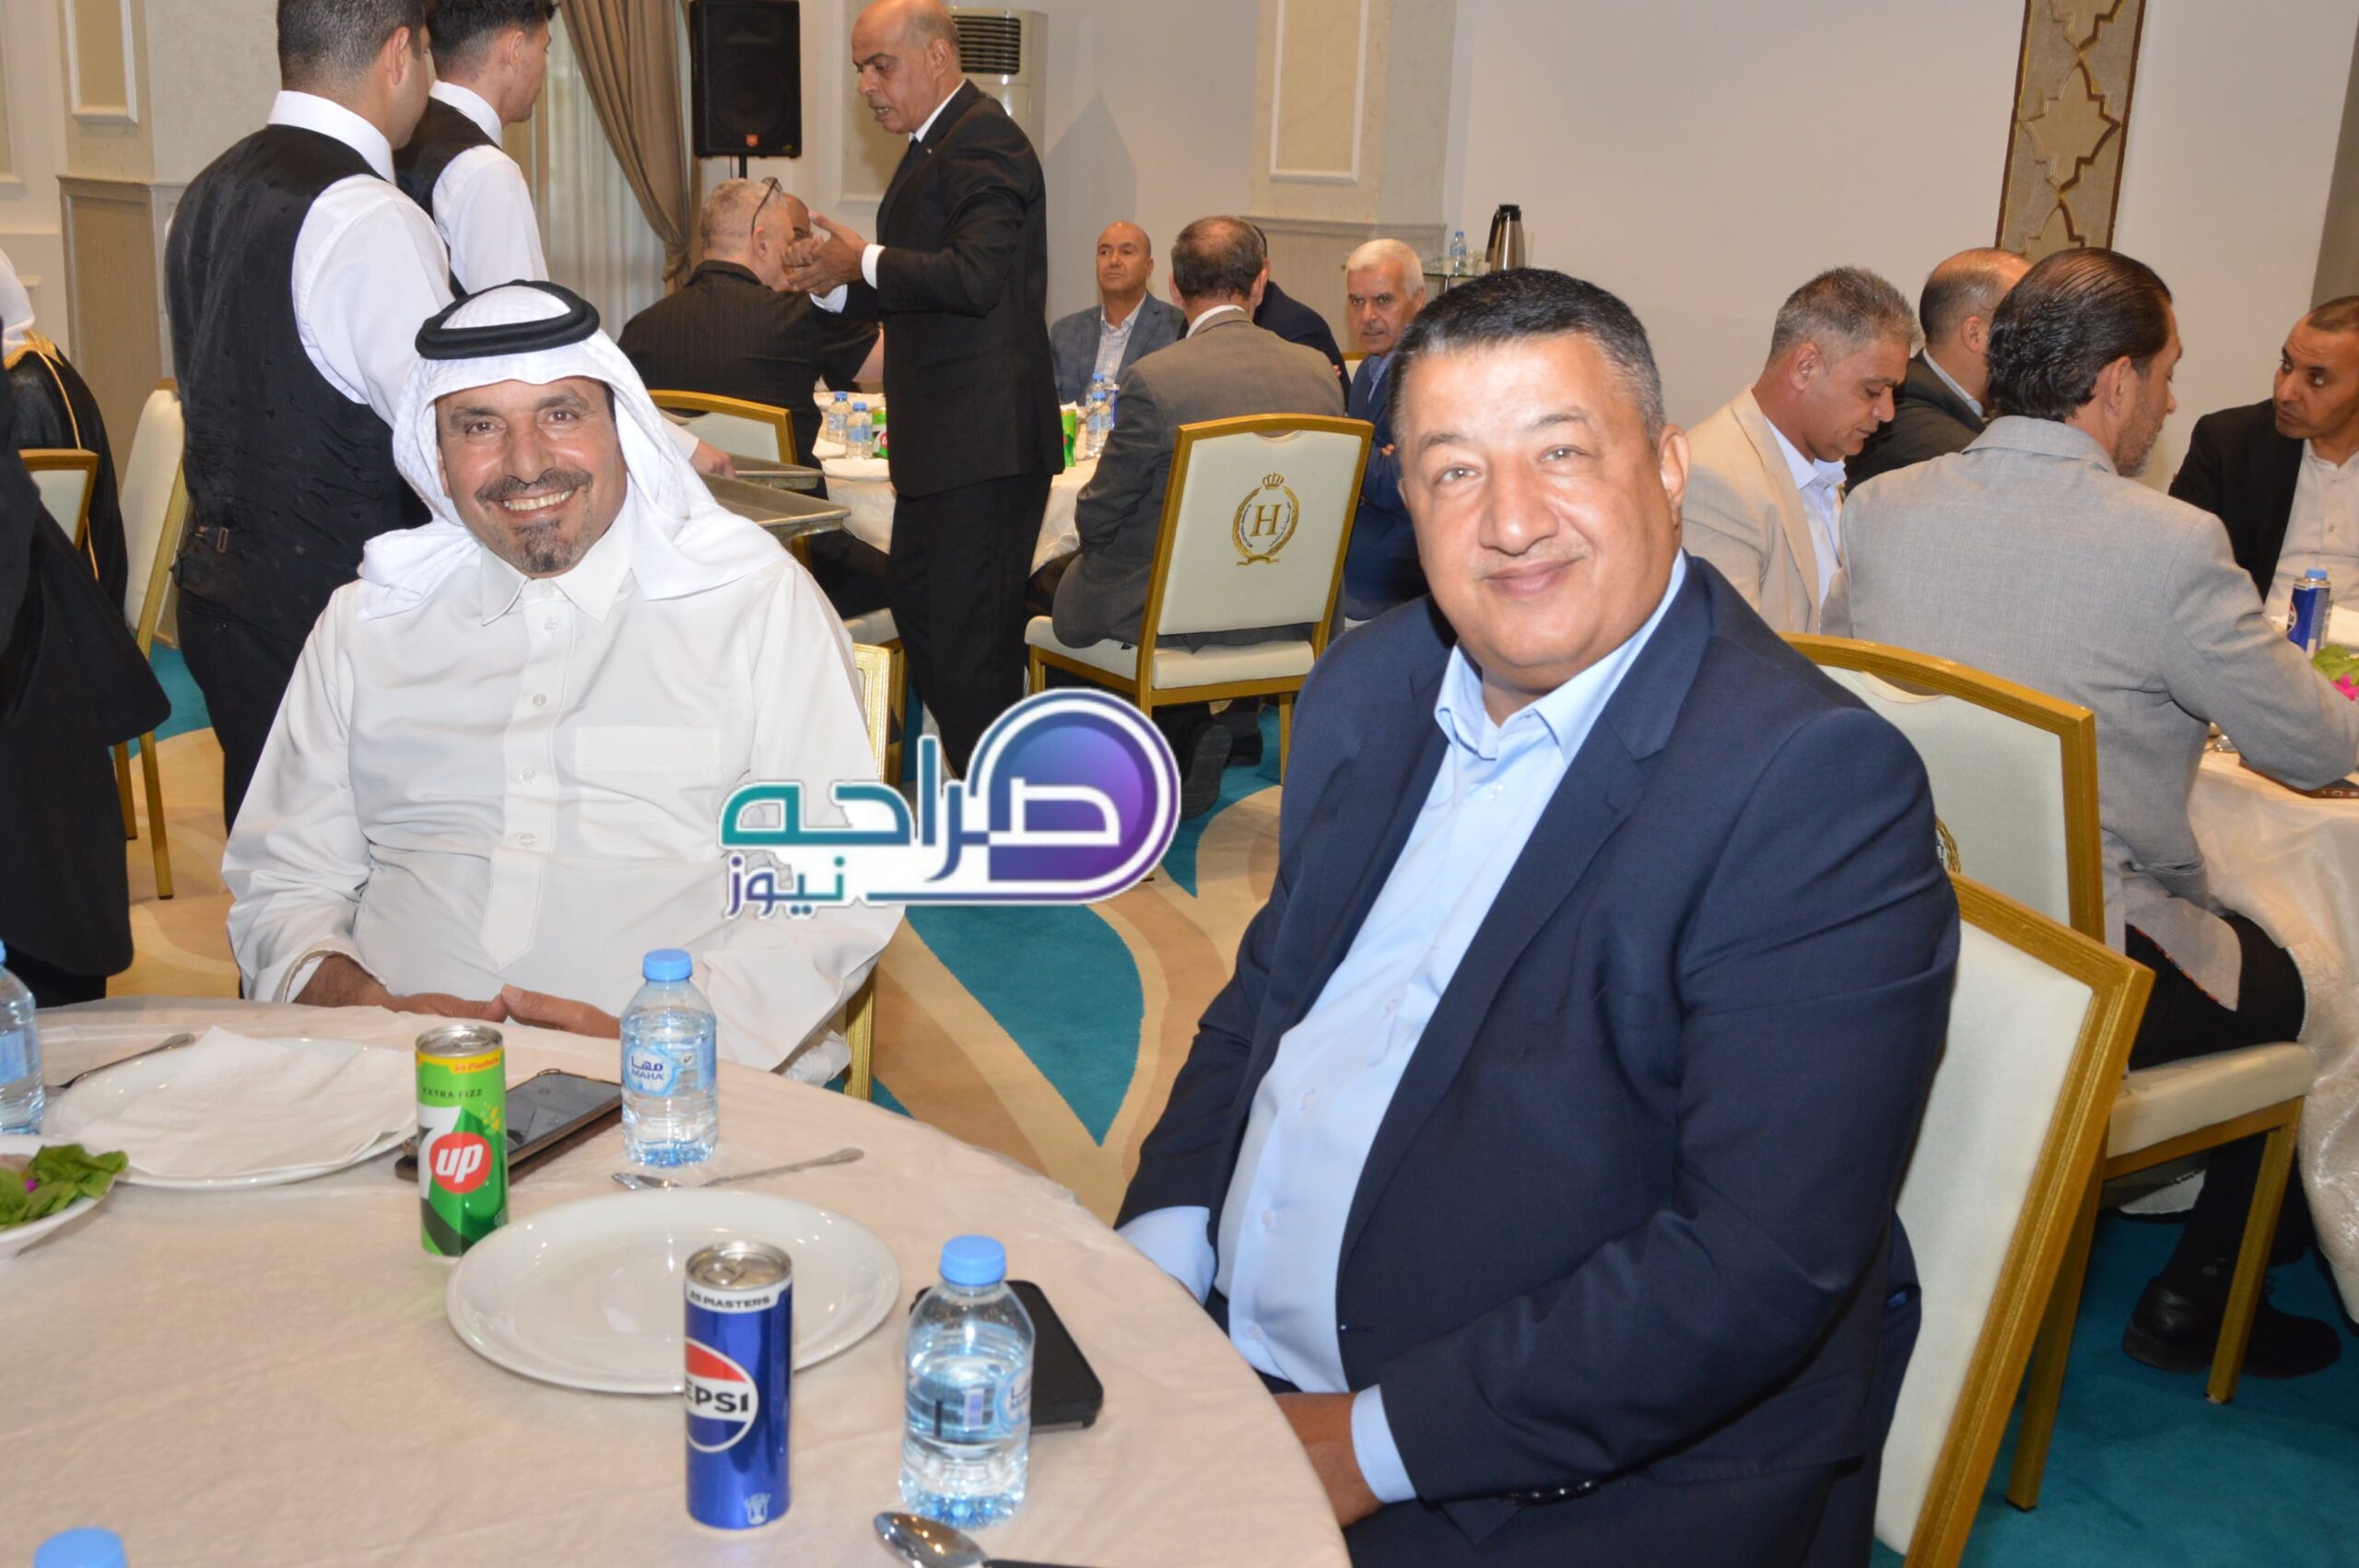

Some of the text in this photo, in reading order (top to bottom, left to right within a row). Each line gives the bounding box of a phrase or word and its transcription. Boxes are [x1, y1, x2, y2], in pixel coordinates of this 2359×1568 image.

[1249, 504, 1284, 536] H
[631, 1055, 663, 1071] مها
[631, 1069, 663, 1081] MAHA
[423, 1087, 482, 1098] EXTRA FIZZ
[703, 1296, 770, 1308] PIASTERS
[685, 1377, 749, 1413] EPSI
